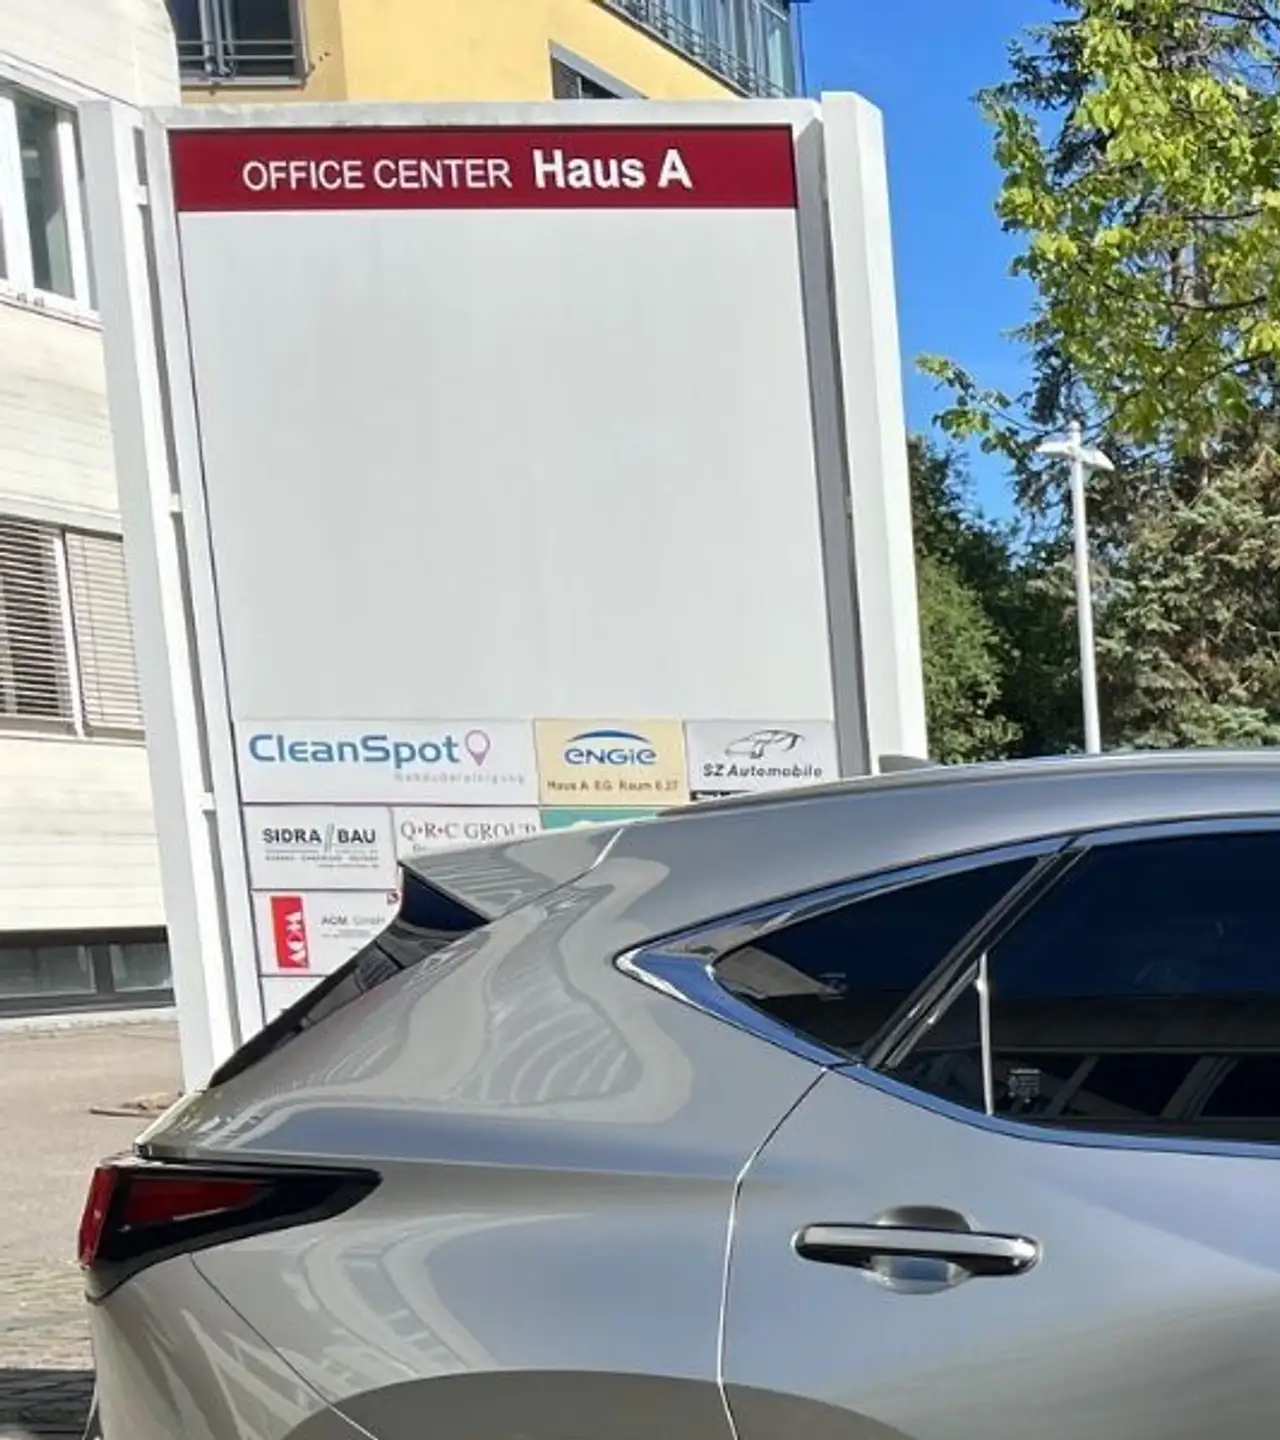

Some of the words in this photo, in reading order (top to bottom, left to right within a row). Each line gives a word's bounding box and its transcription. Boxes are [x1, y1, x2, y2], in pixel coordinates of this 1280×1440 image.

[242, 160, 364, 191] OFFICE
[373, 158, 513, 190] CENTER
[533, 149, 647, 190] Haus
[658, 149, 693, 189] A
[248, 733, 460, 769] CleanSpot
[703, 763, 725, 778] SZ
[728, 763, 823, 778] Automobile
[262, 827, 323, 844] SIDRA
[338, 828, 377, 844] BAU
